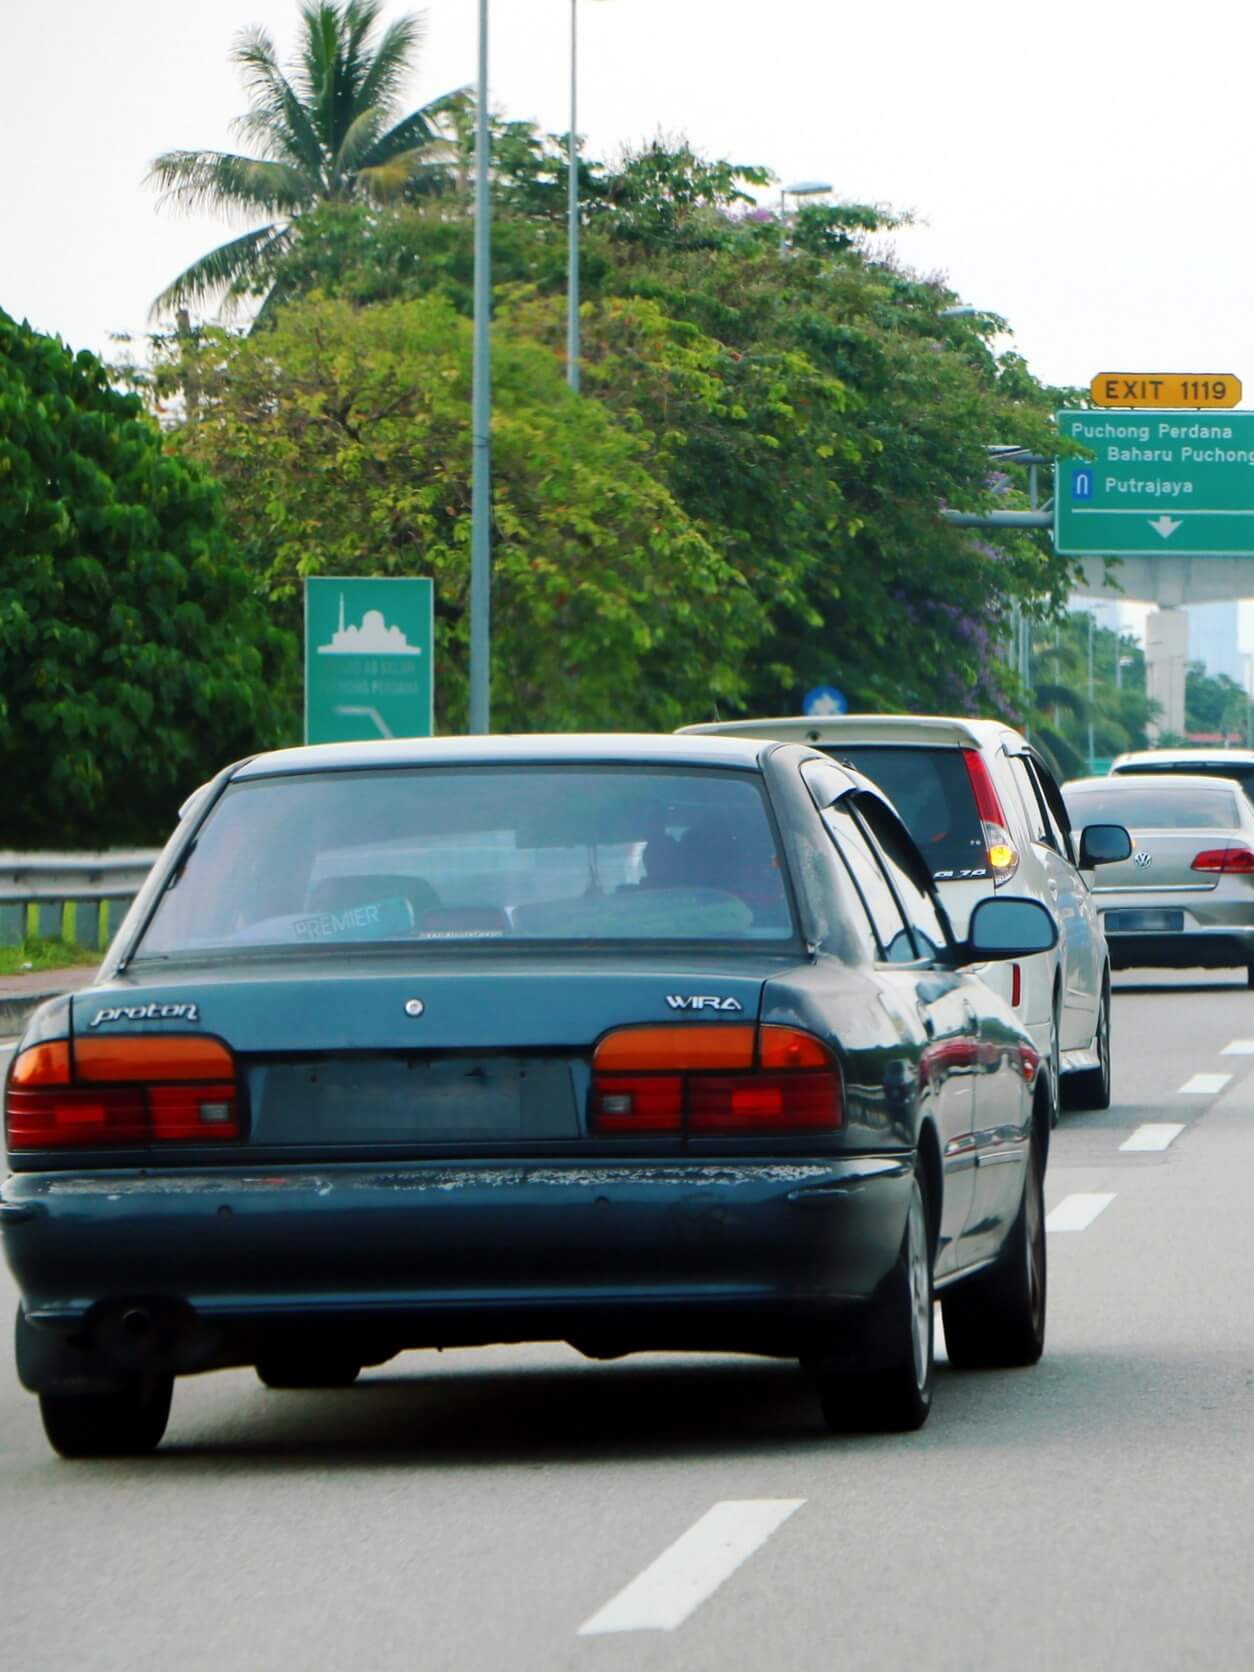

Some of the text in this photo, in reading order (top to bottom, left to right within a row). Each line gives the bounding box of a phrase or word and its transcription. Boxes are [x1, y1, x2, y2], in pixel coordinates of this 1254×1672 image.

[1105, 381, 1226, 400] EXIT 1119
[1072, 423, 1232, 441] Puchong Perdana
[1108, 447, 1172, 461] Baharu
[1106, 478, 1192, 496] Putrajaya
[295, 905, 379, 938] PREMIER
[665, 995, 742, 1010] WIRA
[90, 1003, 198, 1026] proton
